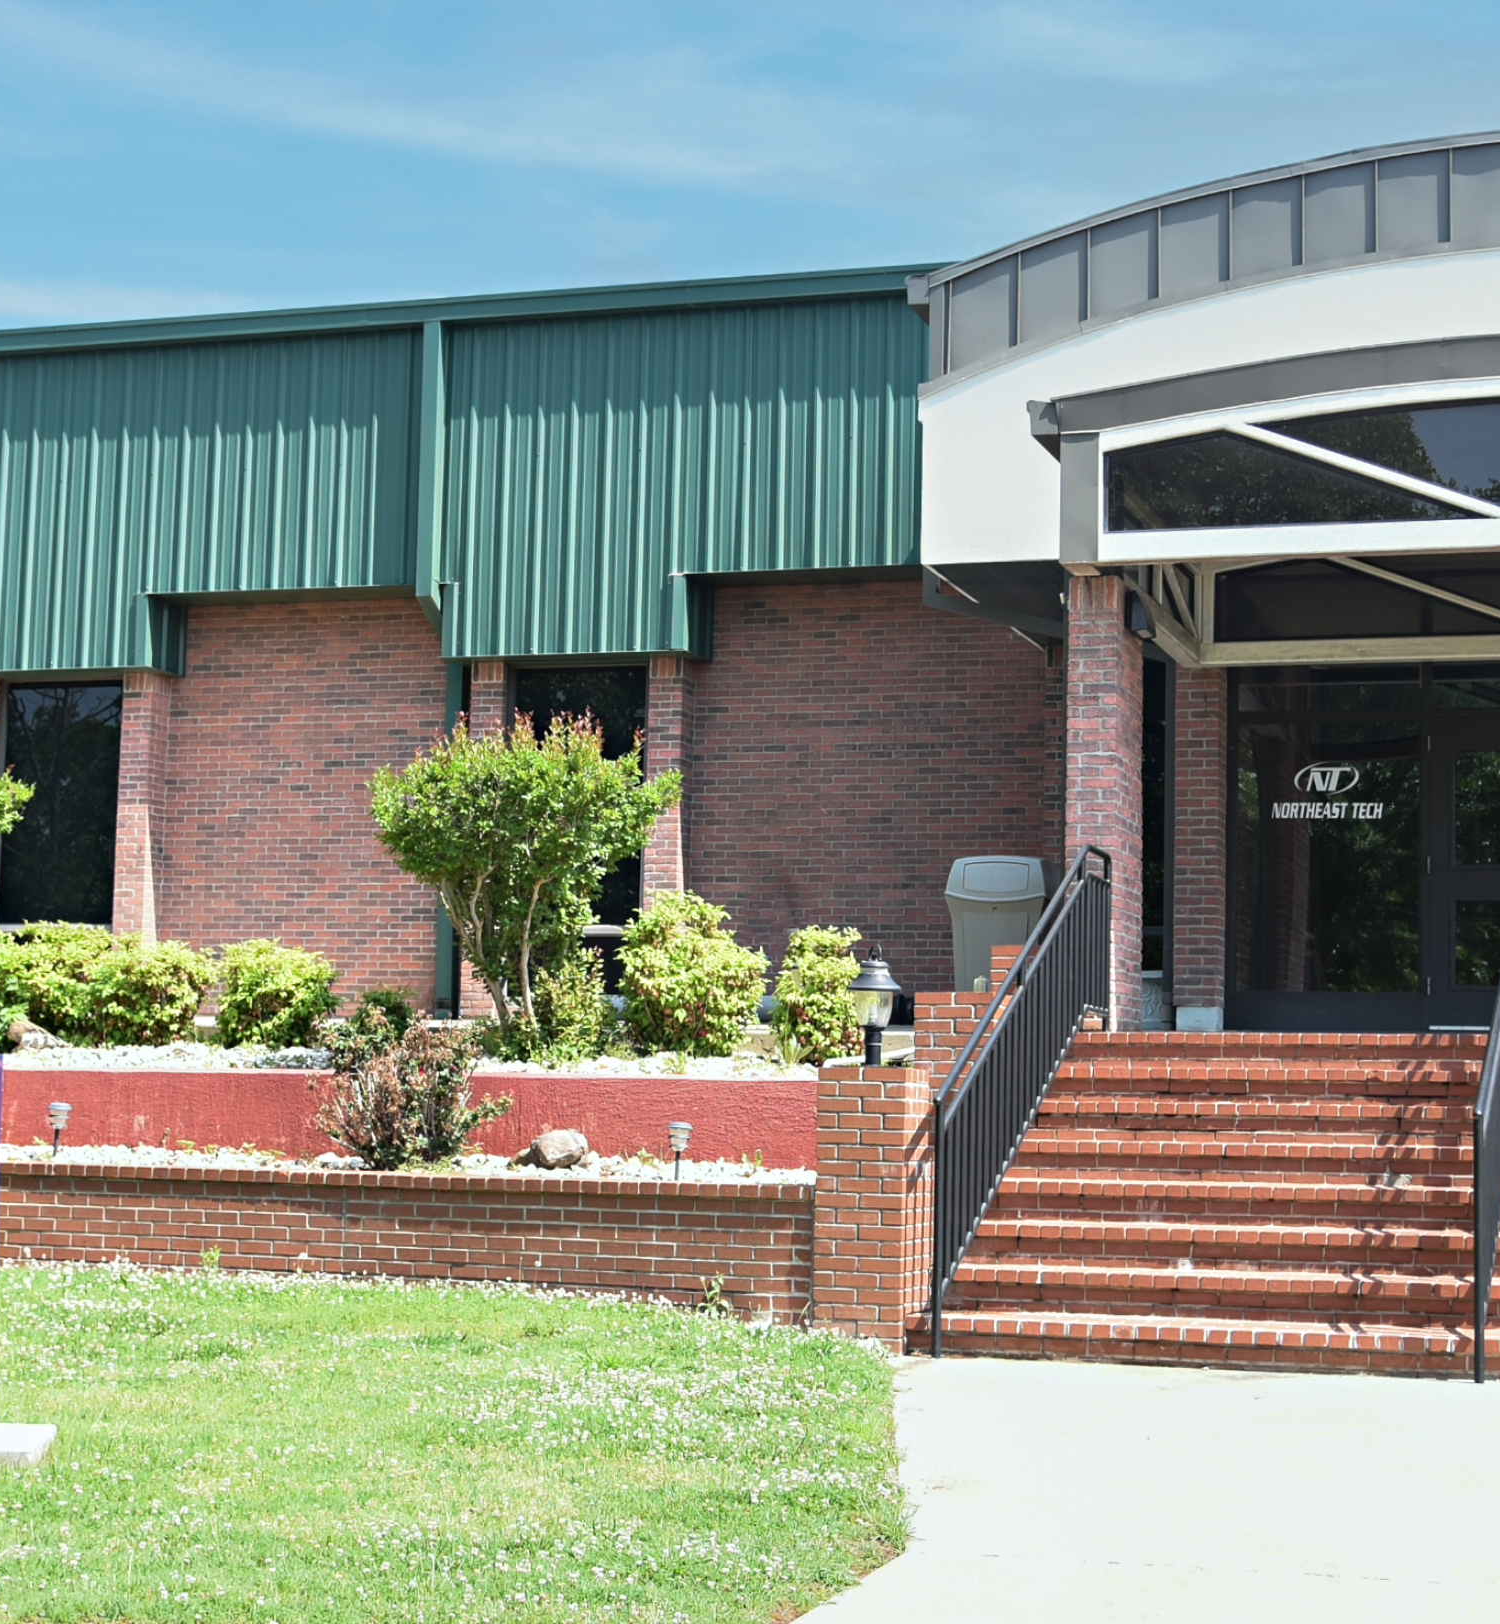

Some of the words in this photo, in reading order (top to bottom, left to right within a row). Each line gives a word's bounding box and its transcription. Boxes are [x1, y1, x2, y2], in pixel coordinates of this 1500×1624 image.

[1305, 766, 1352, 792] NT
[1271, 802, 1349, 819] NORTHEAST
[1351, 802, 1384, 819] TECH
